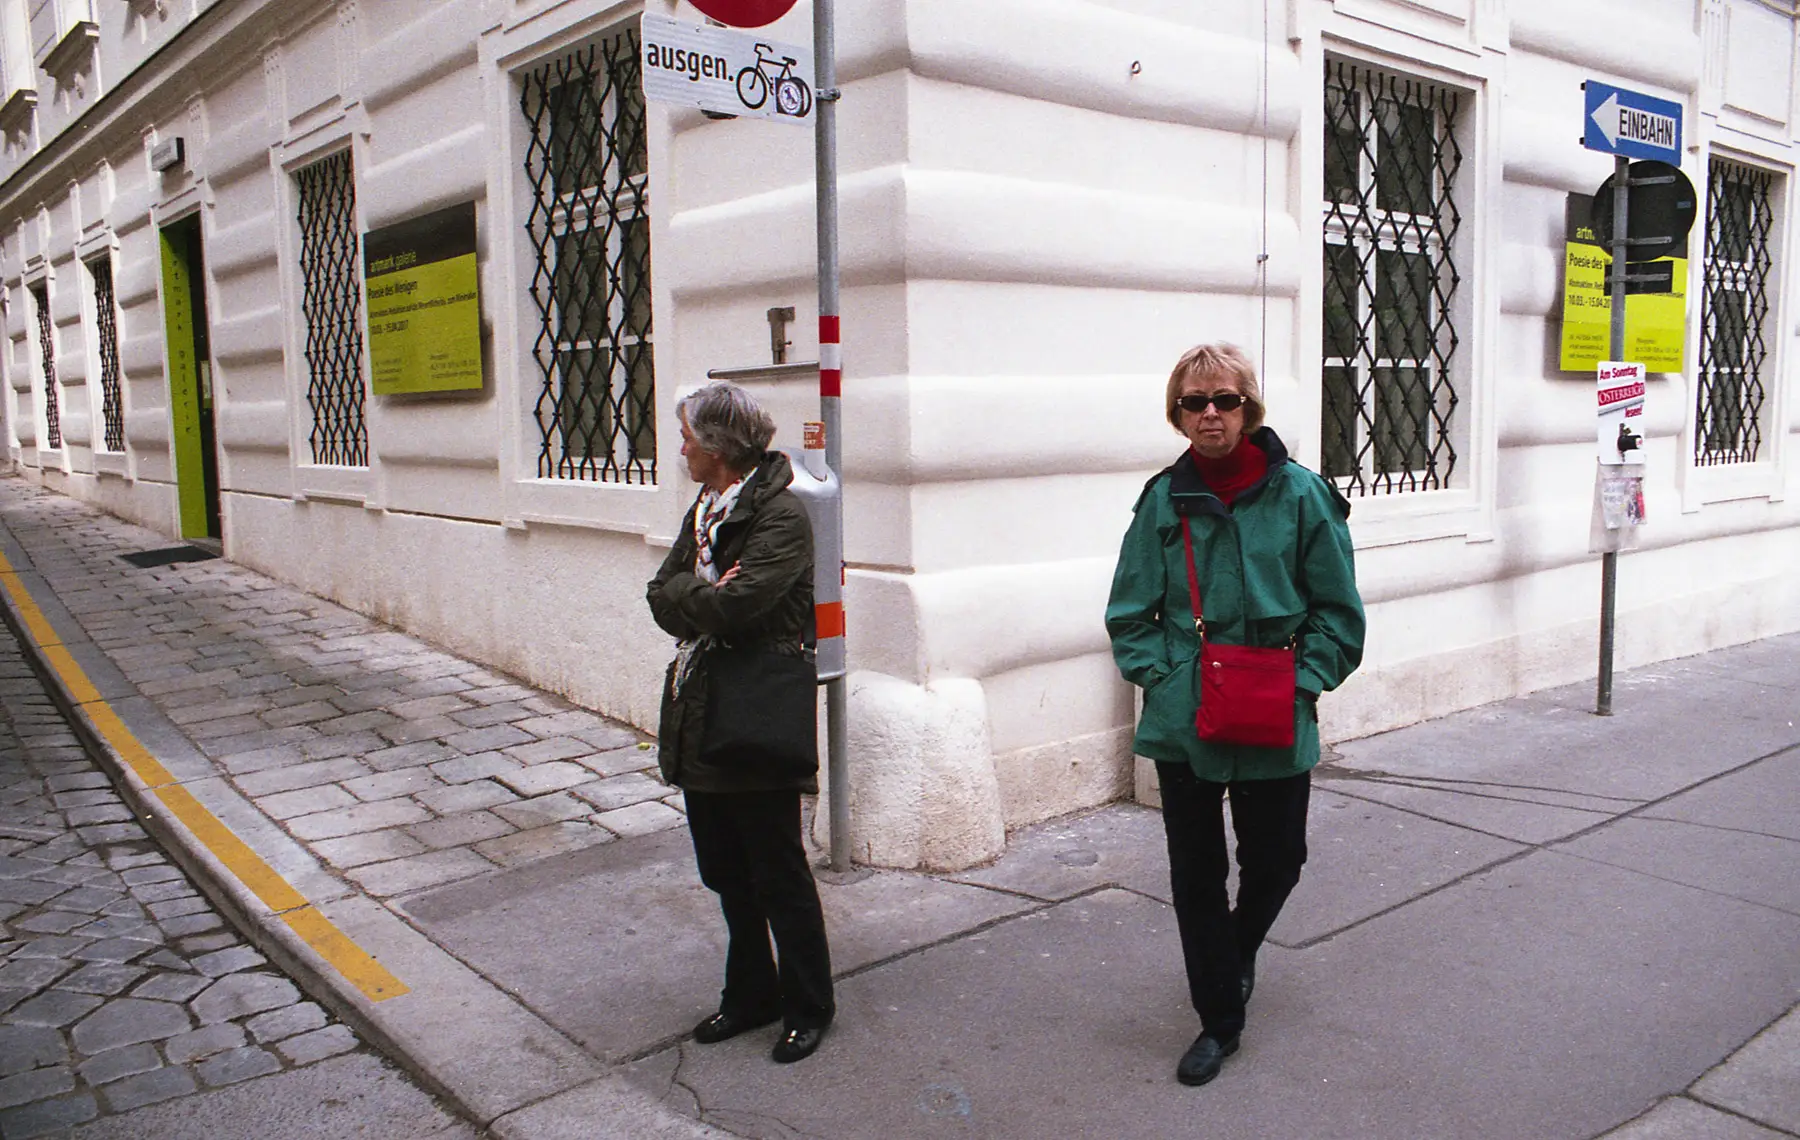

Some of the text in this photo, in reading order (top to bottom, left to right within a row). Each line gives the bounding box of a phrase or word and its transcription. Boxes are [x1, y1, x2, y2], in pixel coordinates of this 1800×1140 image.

[647, 43, 735, 82] ausgen.
[1619, 108, 1673, 146] EINBAHN
[1569, 252, 1590, 268] Poesie
[1592, 255, 1602, 270] des
[1599, 366, 1638, 380] Am Sonntag
